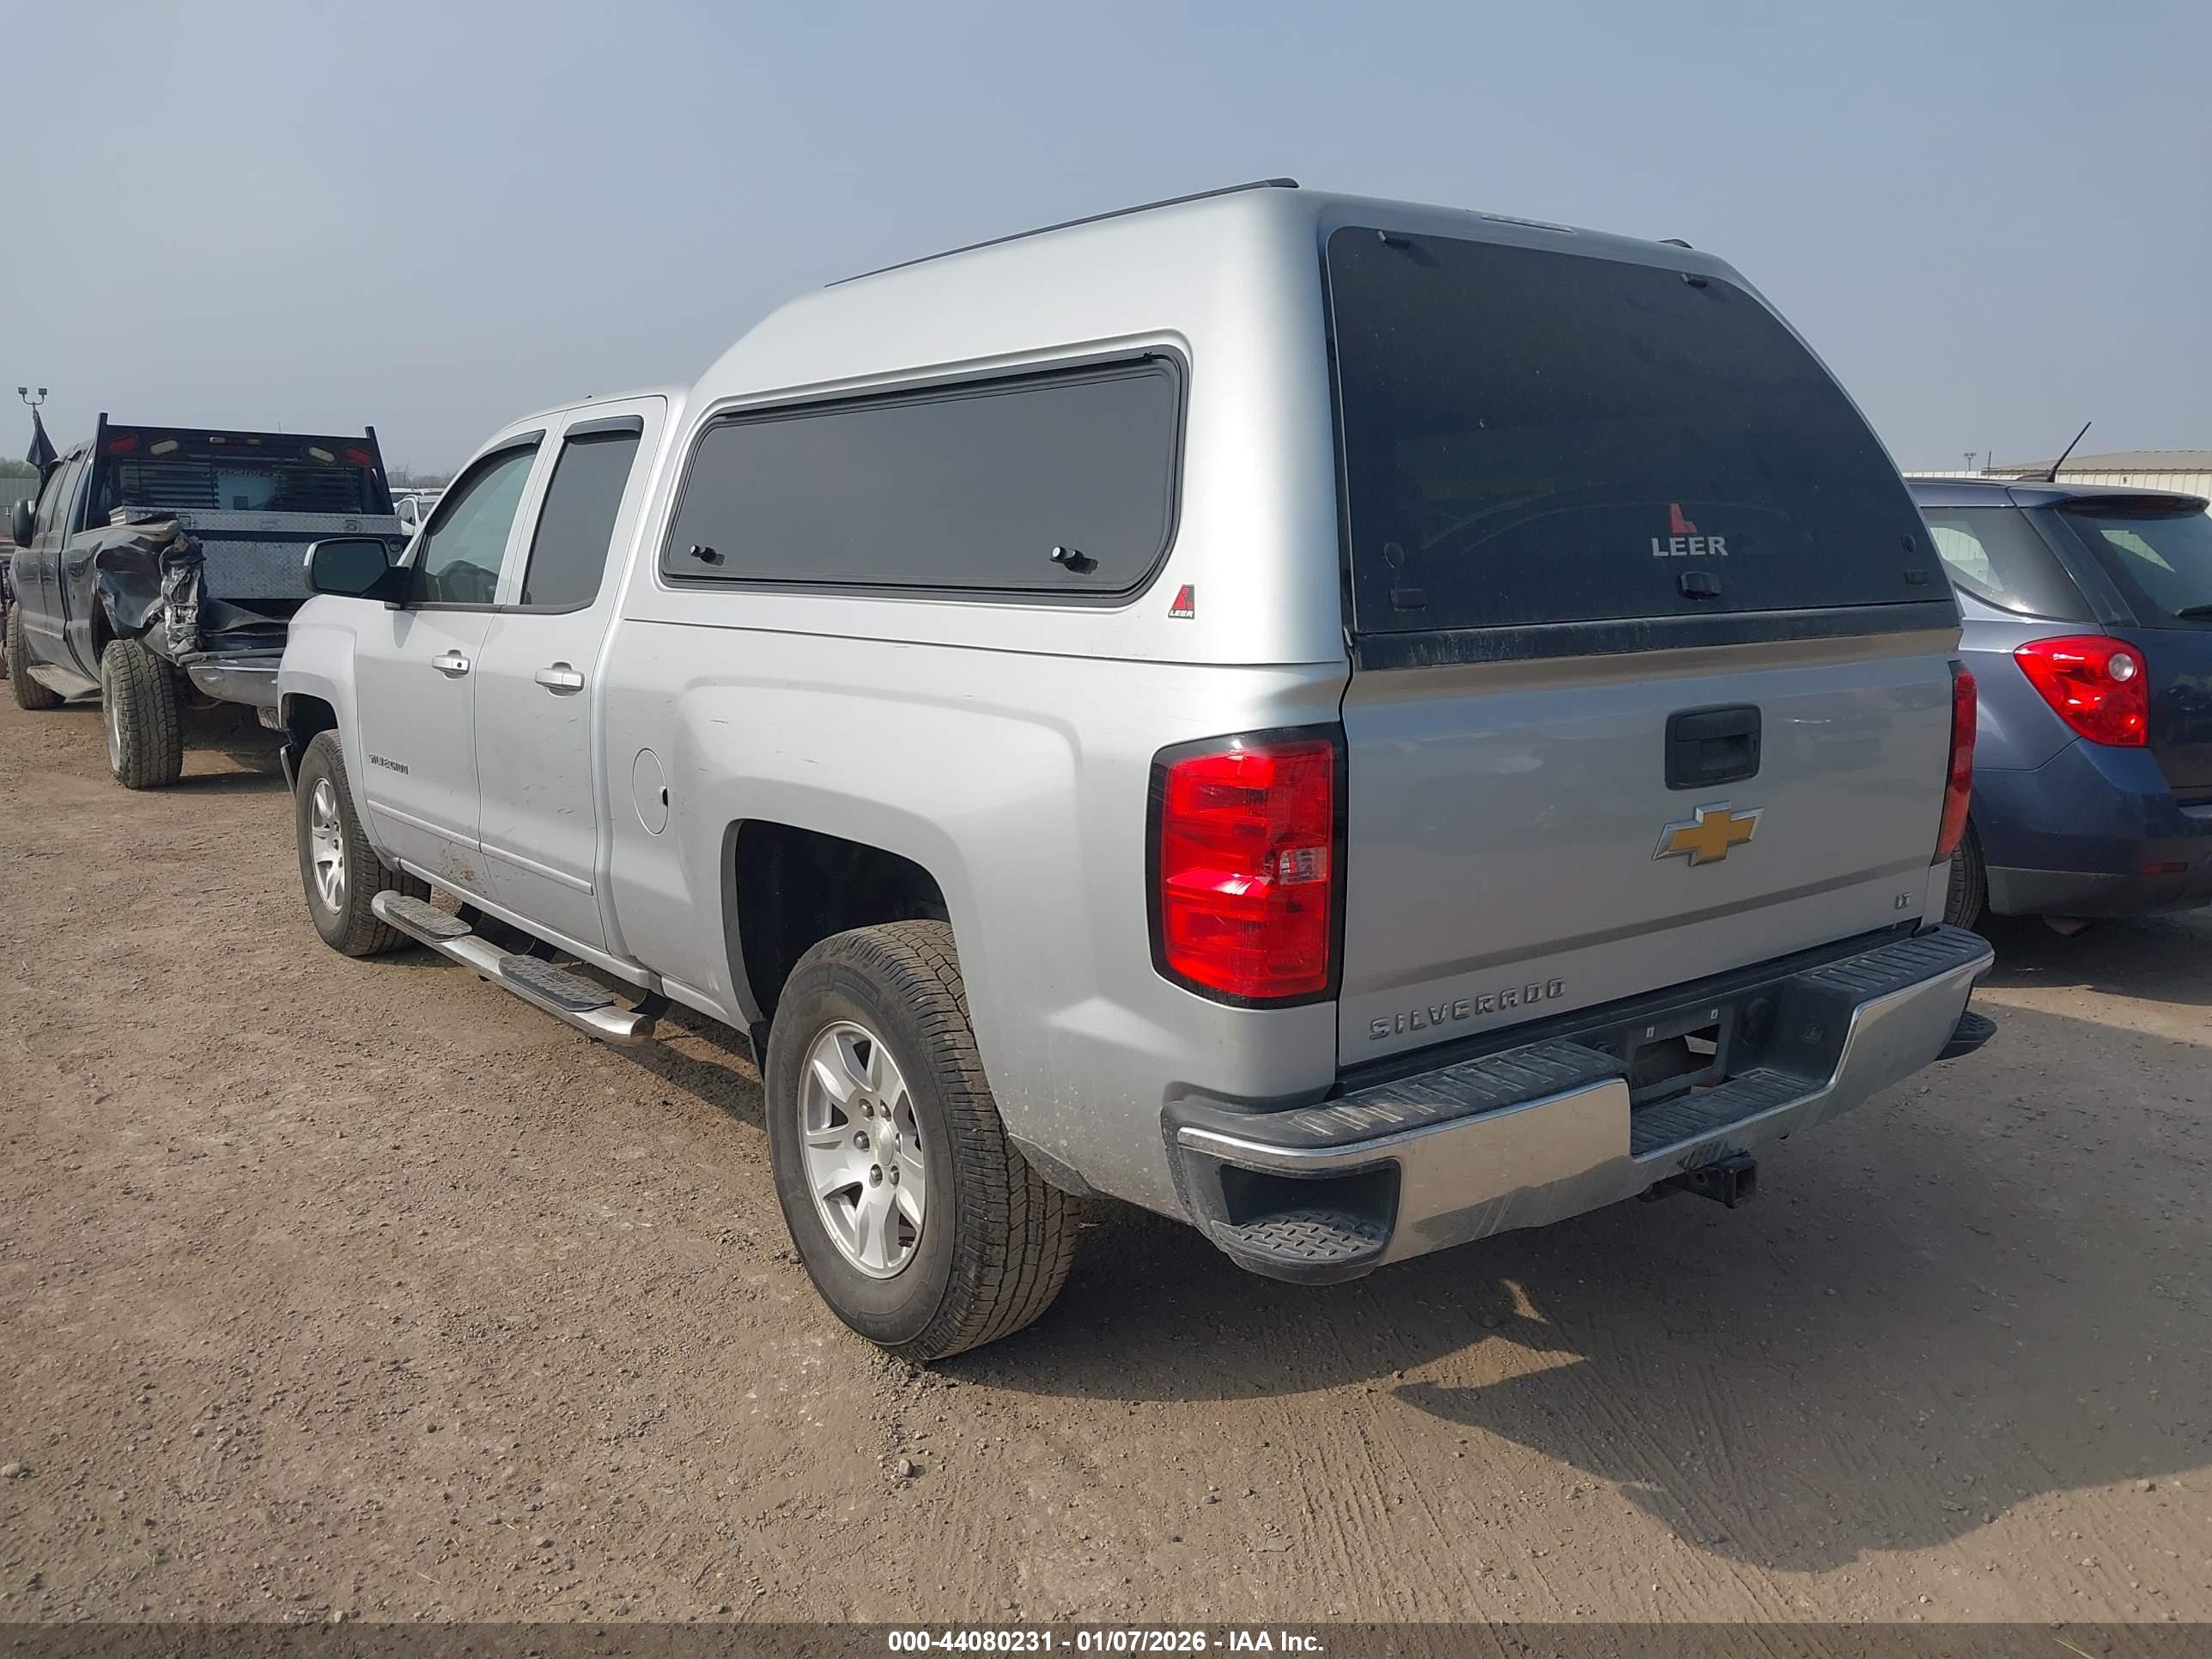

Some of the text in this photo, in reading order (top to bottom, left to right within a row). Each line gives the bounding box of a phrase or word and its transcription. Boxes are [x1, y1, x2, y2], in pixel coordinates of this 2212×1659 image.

[1651, 536, 1729, 556] LEER
[1169, 609, 1194, 618] LEER
[1370, 977, 1566, 1040] SILVERADO
